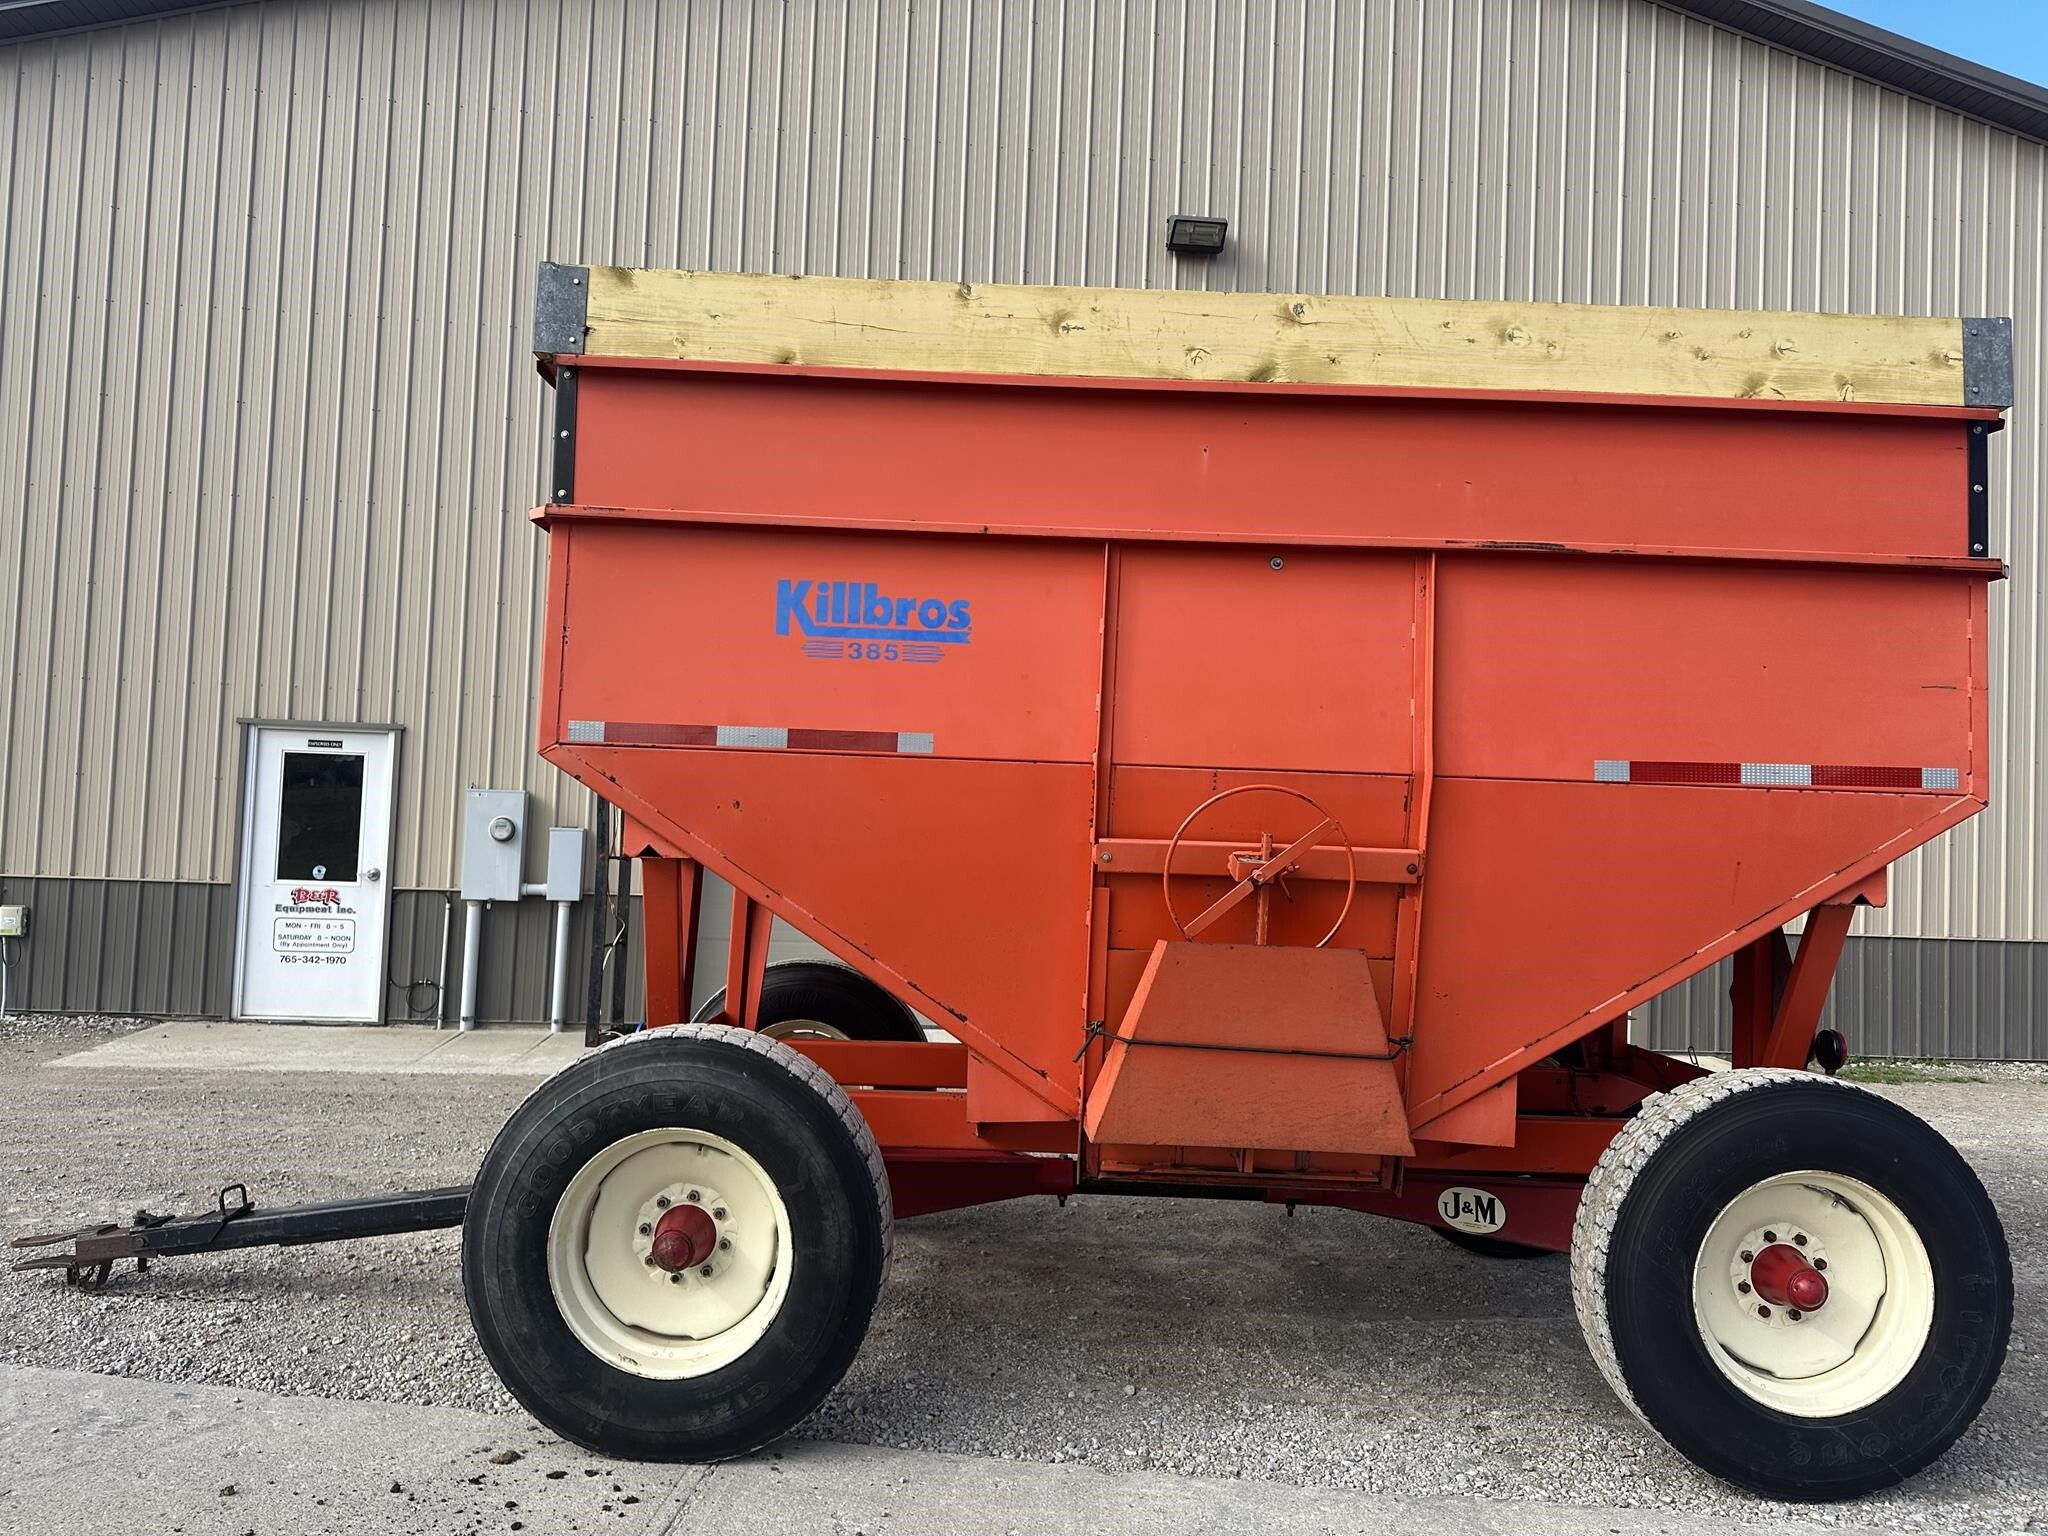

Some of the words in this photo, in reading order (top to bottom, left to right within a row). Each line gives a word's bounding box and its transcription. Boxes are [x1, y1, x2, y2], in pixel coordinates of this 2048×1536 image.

[775, 578, 972, 637] Killbros
[848, 642, 899, 661] 385
[291, 887, 341, 906] B&R
[275, 904, 332, 914] Equipment
[336, 905, 356, 914] Inc.
[280, 955, 347, 965] 765-342-1970
[517, 1093, 746, 1217] GOODYEAR
[1442, 1191, 1498, 1226] J&M
